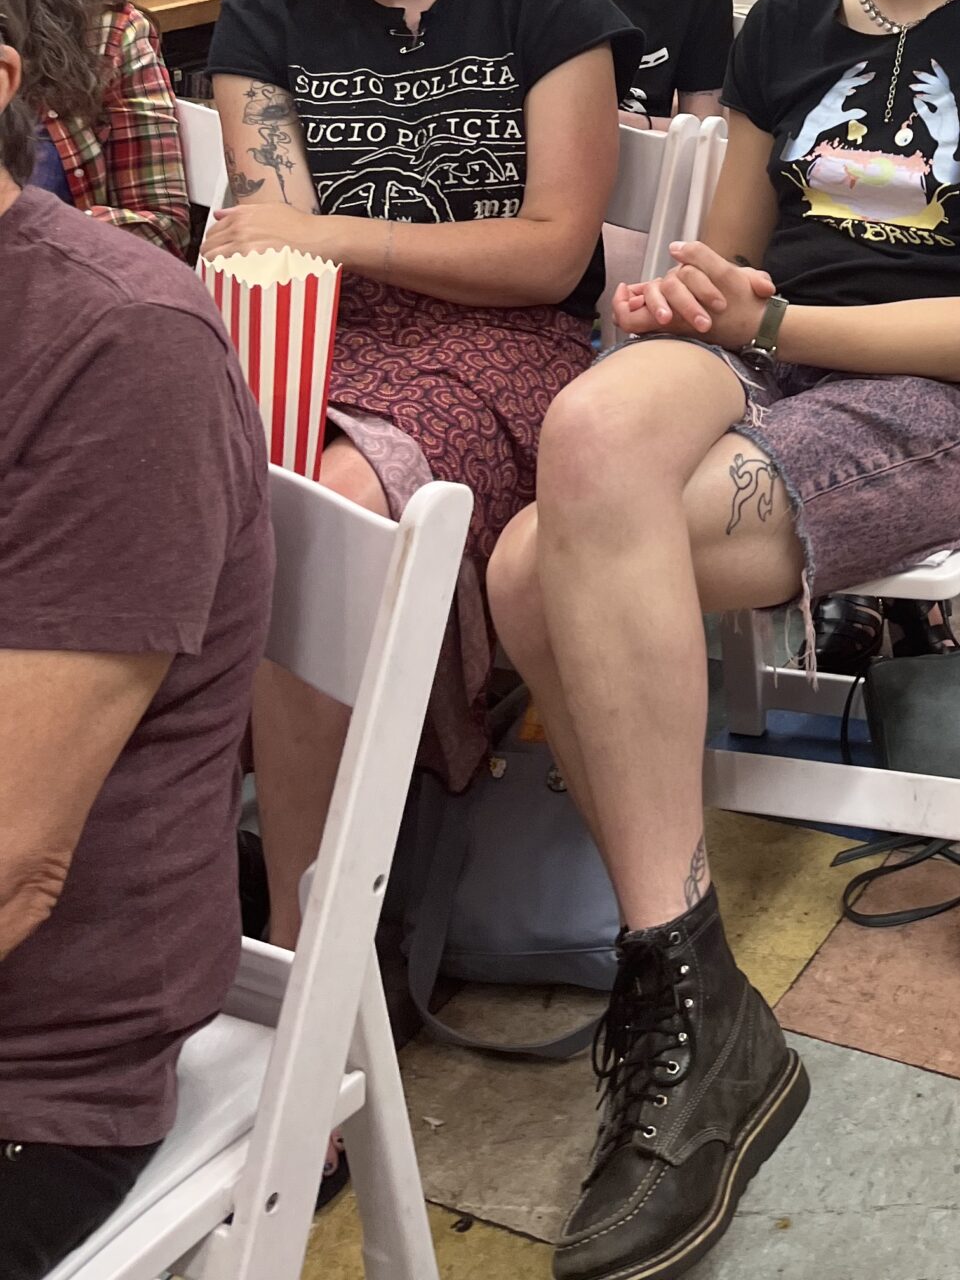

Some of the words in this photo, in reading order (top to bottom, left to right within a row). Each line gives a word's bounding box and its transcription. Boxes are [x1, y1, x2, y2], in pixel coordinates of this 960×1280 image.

[295, 74, 384, 99] SUCIO
[394, 61, 515, 101] POLICÍA
[302, 121, 387, 152] UCIO
